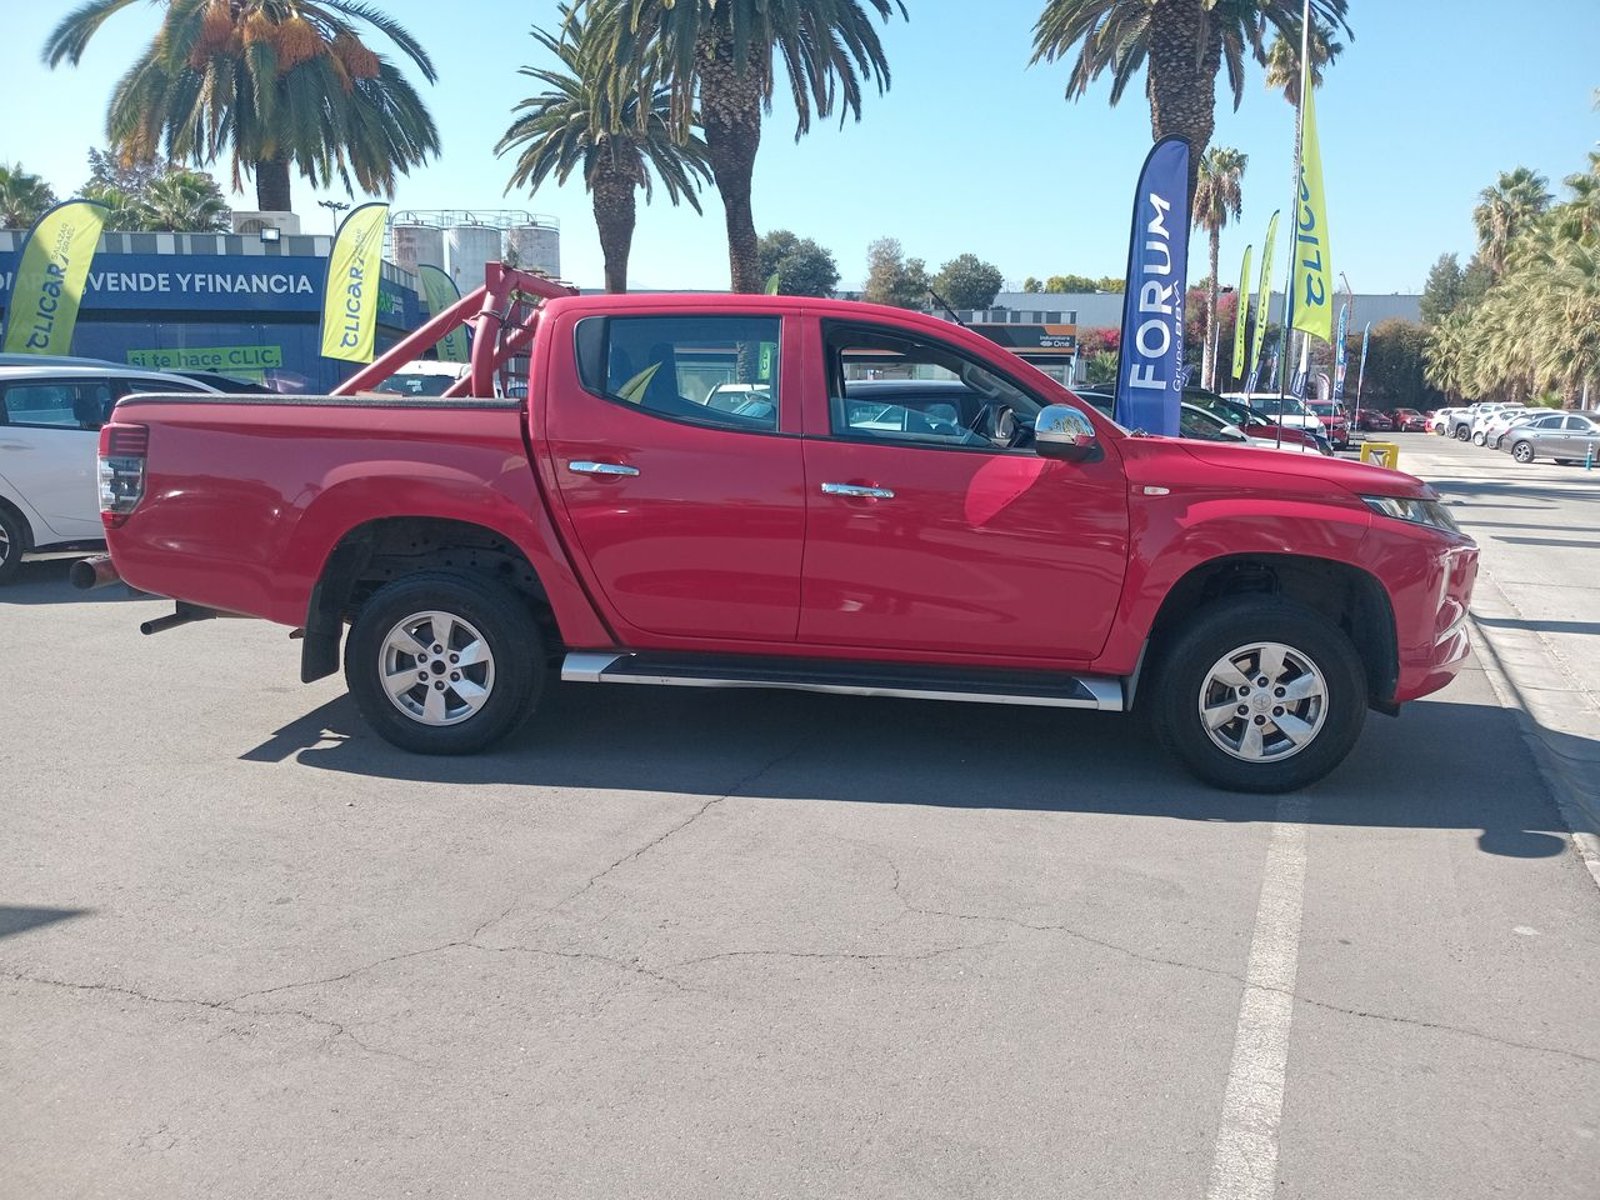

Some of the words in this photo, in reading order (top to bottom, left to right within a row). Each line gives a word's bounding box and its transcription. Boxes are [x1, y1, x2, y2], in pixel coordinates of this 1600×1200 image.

[89, 273, 171, 292] VENDE
[1129, 193, 1173, 390] FORUM
[1173, 280, 1182, 337] BBVA
[131, 353, 147, 366] si
[152, 353, 171, 367] te
[178, 351, 222, 367] hace
[1172, 340, 1182, 392] Grupo
